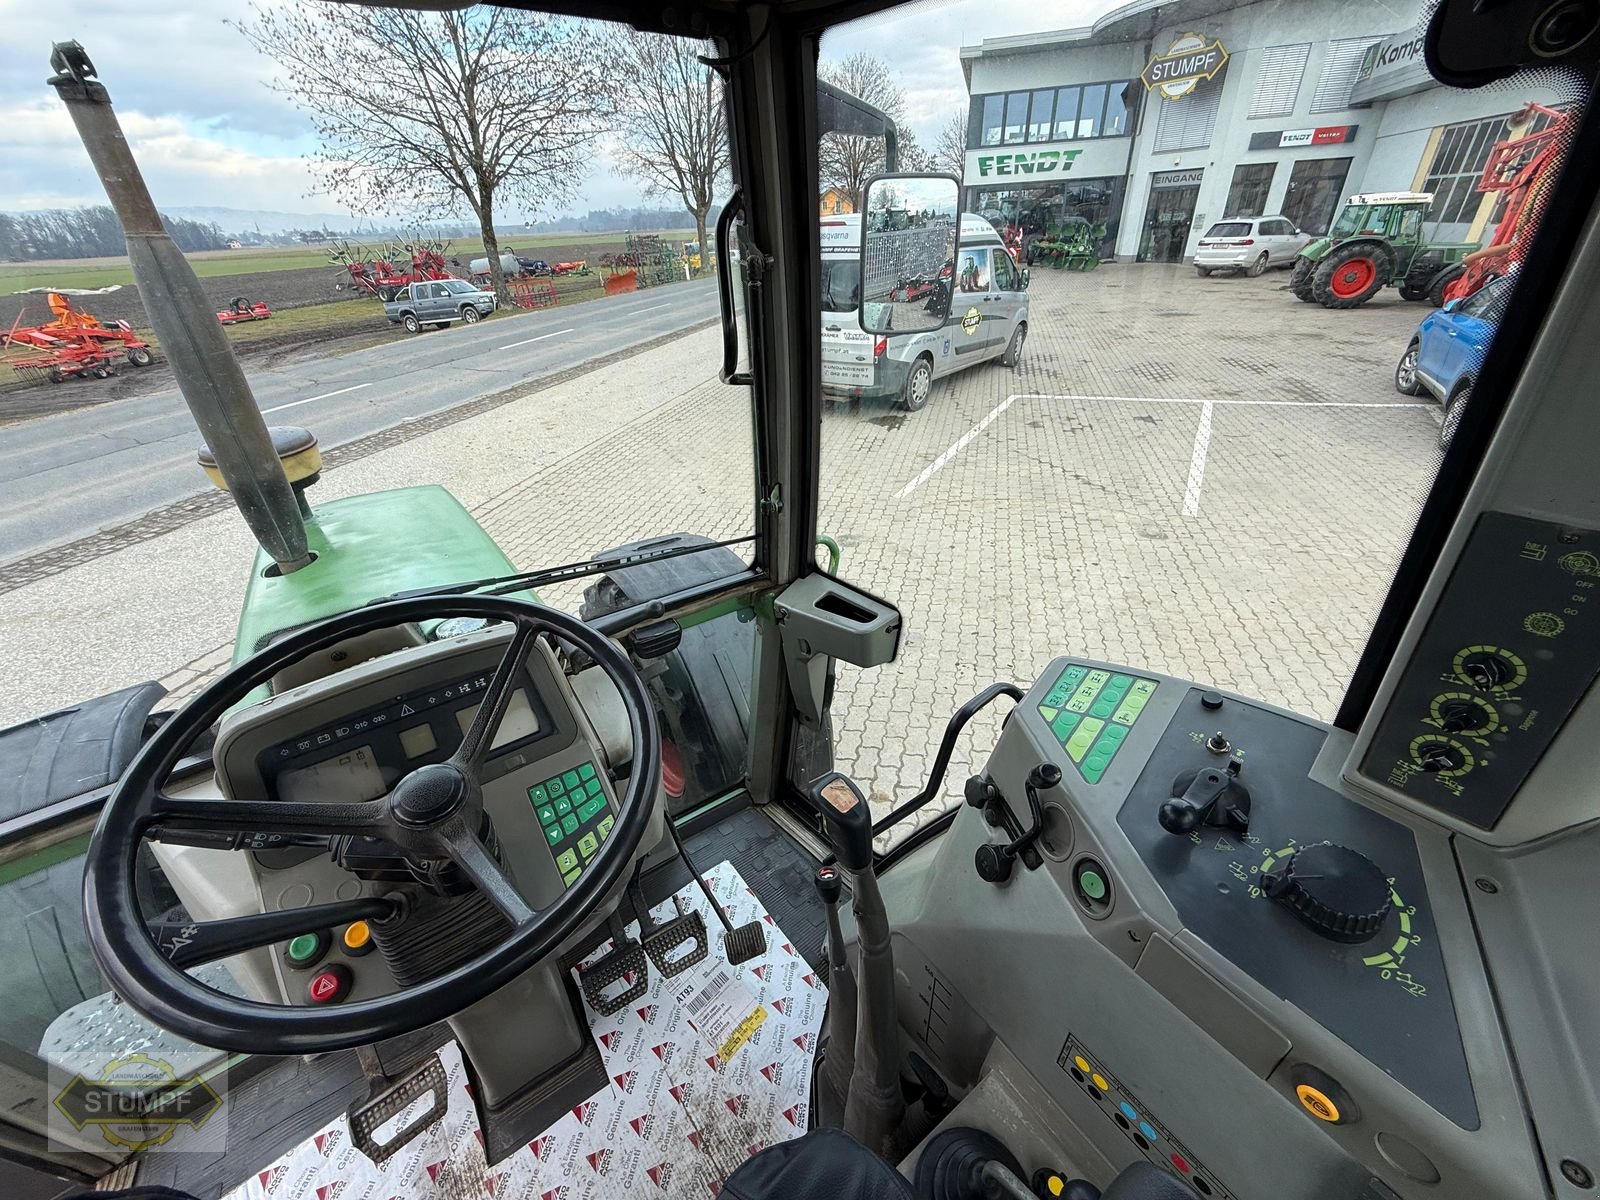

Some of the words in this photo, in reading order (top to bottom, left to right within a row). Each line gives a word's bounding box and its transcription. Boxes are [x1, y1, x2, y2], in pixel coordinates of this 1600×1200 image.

[1152, 52, 1216, 80] STUMPF
[1377, 38, 1424, 68] Komp
[1283, 134, 1312, 142] FENDT
[978, 150, 1083, 176] FENDT
[1154, 174, 1203, 184] EINGANG
[1575, 580, 1594, 589] OFF
[1572, 594, 1587, 603] ON
[1262, 848, 1271, 856] 8
[1250, 866, 1258, 874] 9
[1248, 884, 1260, 896] 10
[1406, 906, 1416, 916] 3
[1410, 935, 1422, 946] 2
[1398, 955, 1405, 964] 1
[1381, 969, 1391, 980] 0
[675, 985, 694, 1004] AT93
[648, 1004, 656, 1024] AGCO
[802, 993, 812, 1025] Genuine
[611, 1031, 621, 1051] AGCO
[627, 1027, 644, 1063] Genuine
[776, 1024, 785, 1054] Garanti
[664, 1042, 673, 1063] AGCO
[686, 1040, 700, 1076] Genuine
[736, 1048, 748, 1086] Genuine
[798, 1059, 808, 1096] Genuine
[626, 1070, 635, 1093] AGCO
[648, 1068, 665, 1107] Genuina
[584, 1102, 595, 1126] AGCO
[607, 1099, 626, 1141] Genuine
[642, 1114, 652, 1140] AGCO
[323, 1130, 340, 1156] AGCO
[451, 1110, 473, 1155] Original
[660, 1110, 677, 1152] Genuine
[540, 1135, 553, 1162] AGCO
[563, 1132, 584, 1177] Genuina
[400, 1139, 427, 1187] Genuine
[599, 1149, 610, 1175] AGCO
[624, 1149, 641, 1189] Garanti
[268, 1165, 287, 1193] AGCO
